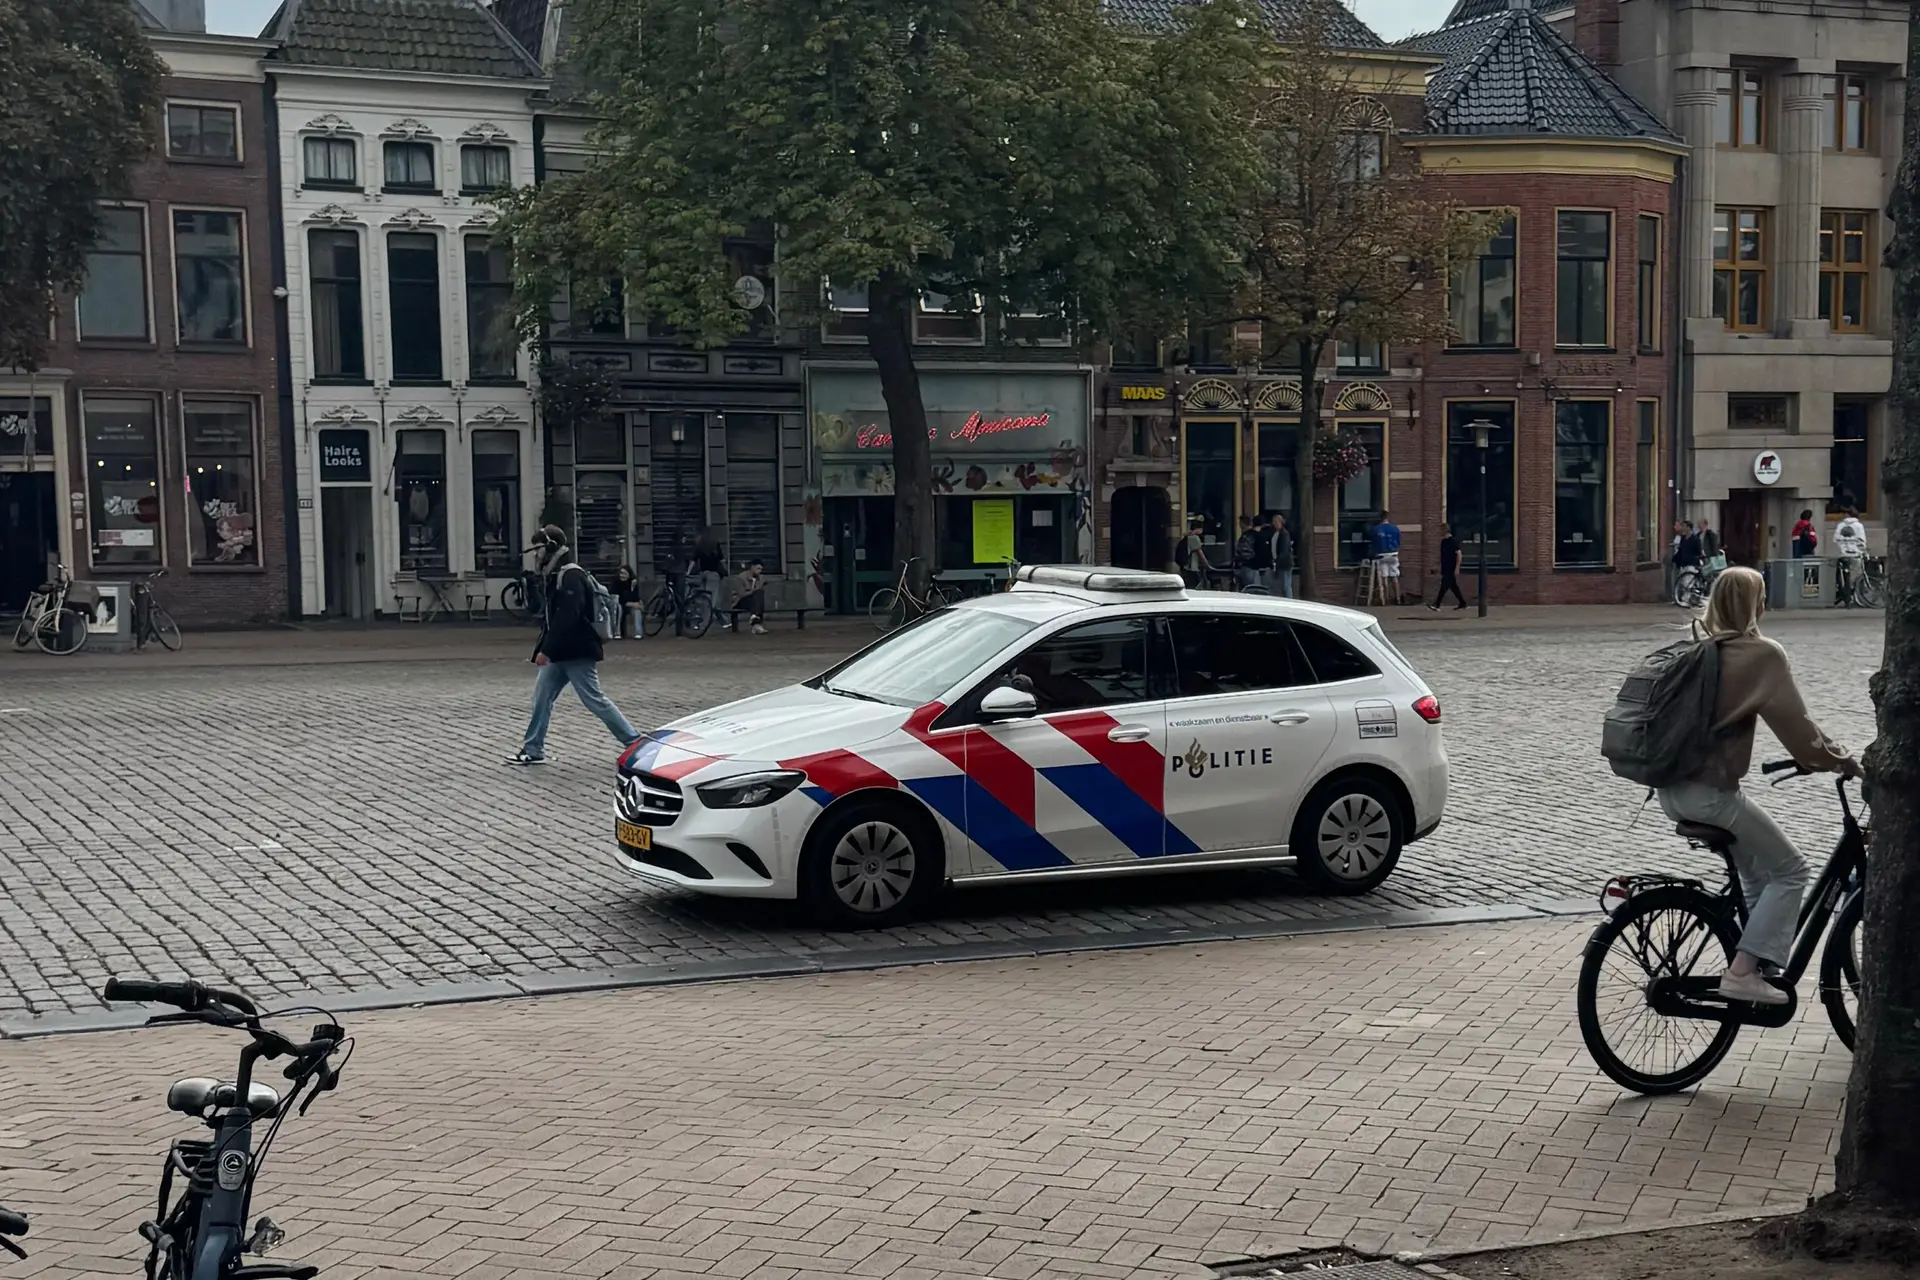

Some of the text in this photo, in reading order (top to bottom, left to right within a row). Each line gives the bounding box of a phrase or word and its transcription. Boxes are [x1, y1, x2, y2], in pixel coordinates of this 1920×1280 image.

[1122, 386, 1166, 400] MAAS
[856, 423, 938, 449] Cana
[325, 456, 363, 466] Looks
[1172, 747, 1273, 779] POLITIE
